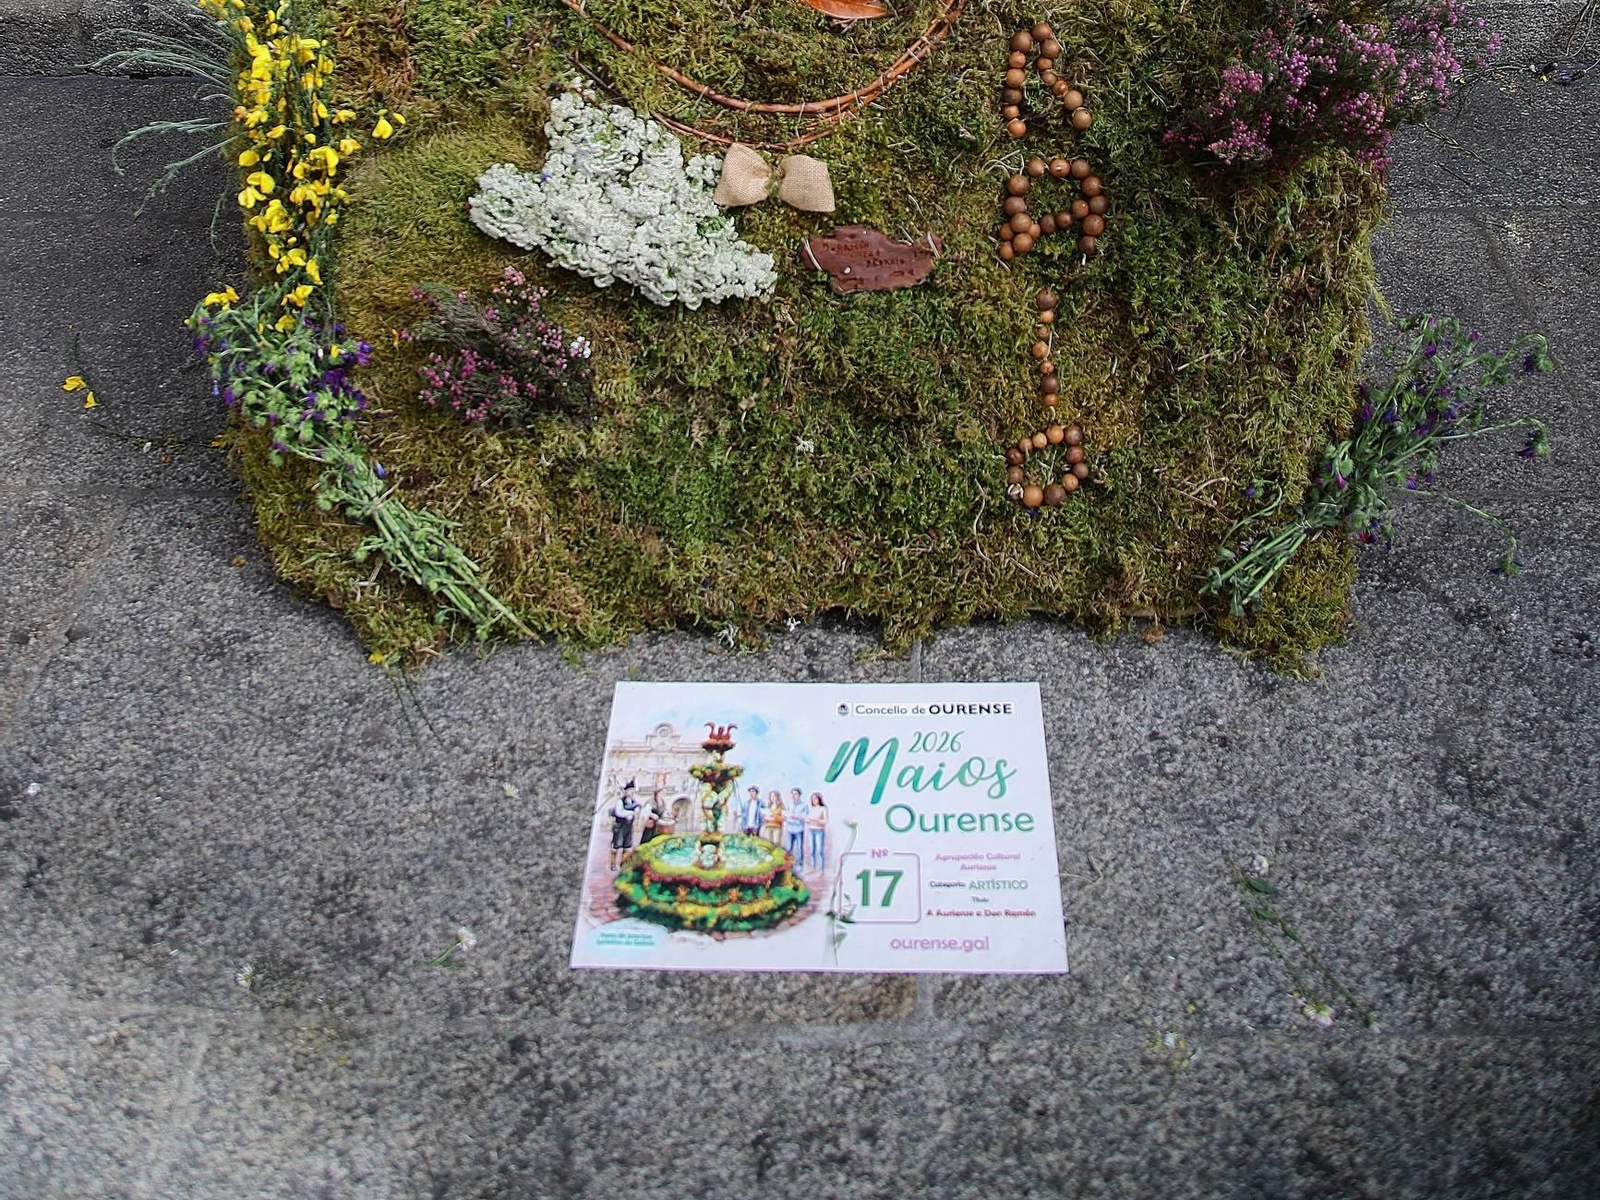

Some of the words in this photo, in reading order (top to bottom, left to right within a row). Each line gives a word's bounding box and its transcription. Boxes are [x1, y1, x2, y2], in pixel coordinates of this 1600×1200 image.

[855, 704, 908, 715] Concello
[912, 704, 926, 715] de
[929, 704, 1013, 715] OURENSE
[908, 730, 965, 753] 2026
[824, 736, 1018, 805] Maios
[885, 803, 1035, 832] Ourense
[871, 848, 889, 858] Nº
[856, 868, 904, 907] 17
[969, 878, 1029, 890] ARTÍSTICO
[890, 934, 990, 950] ourense.gal
